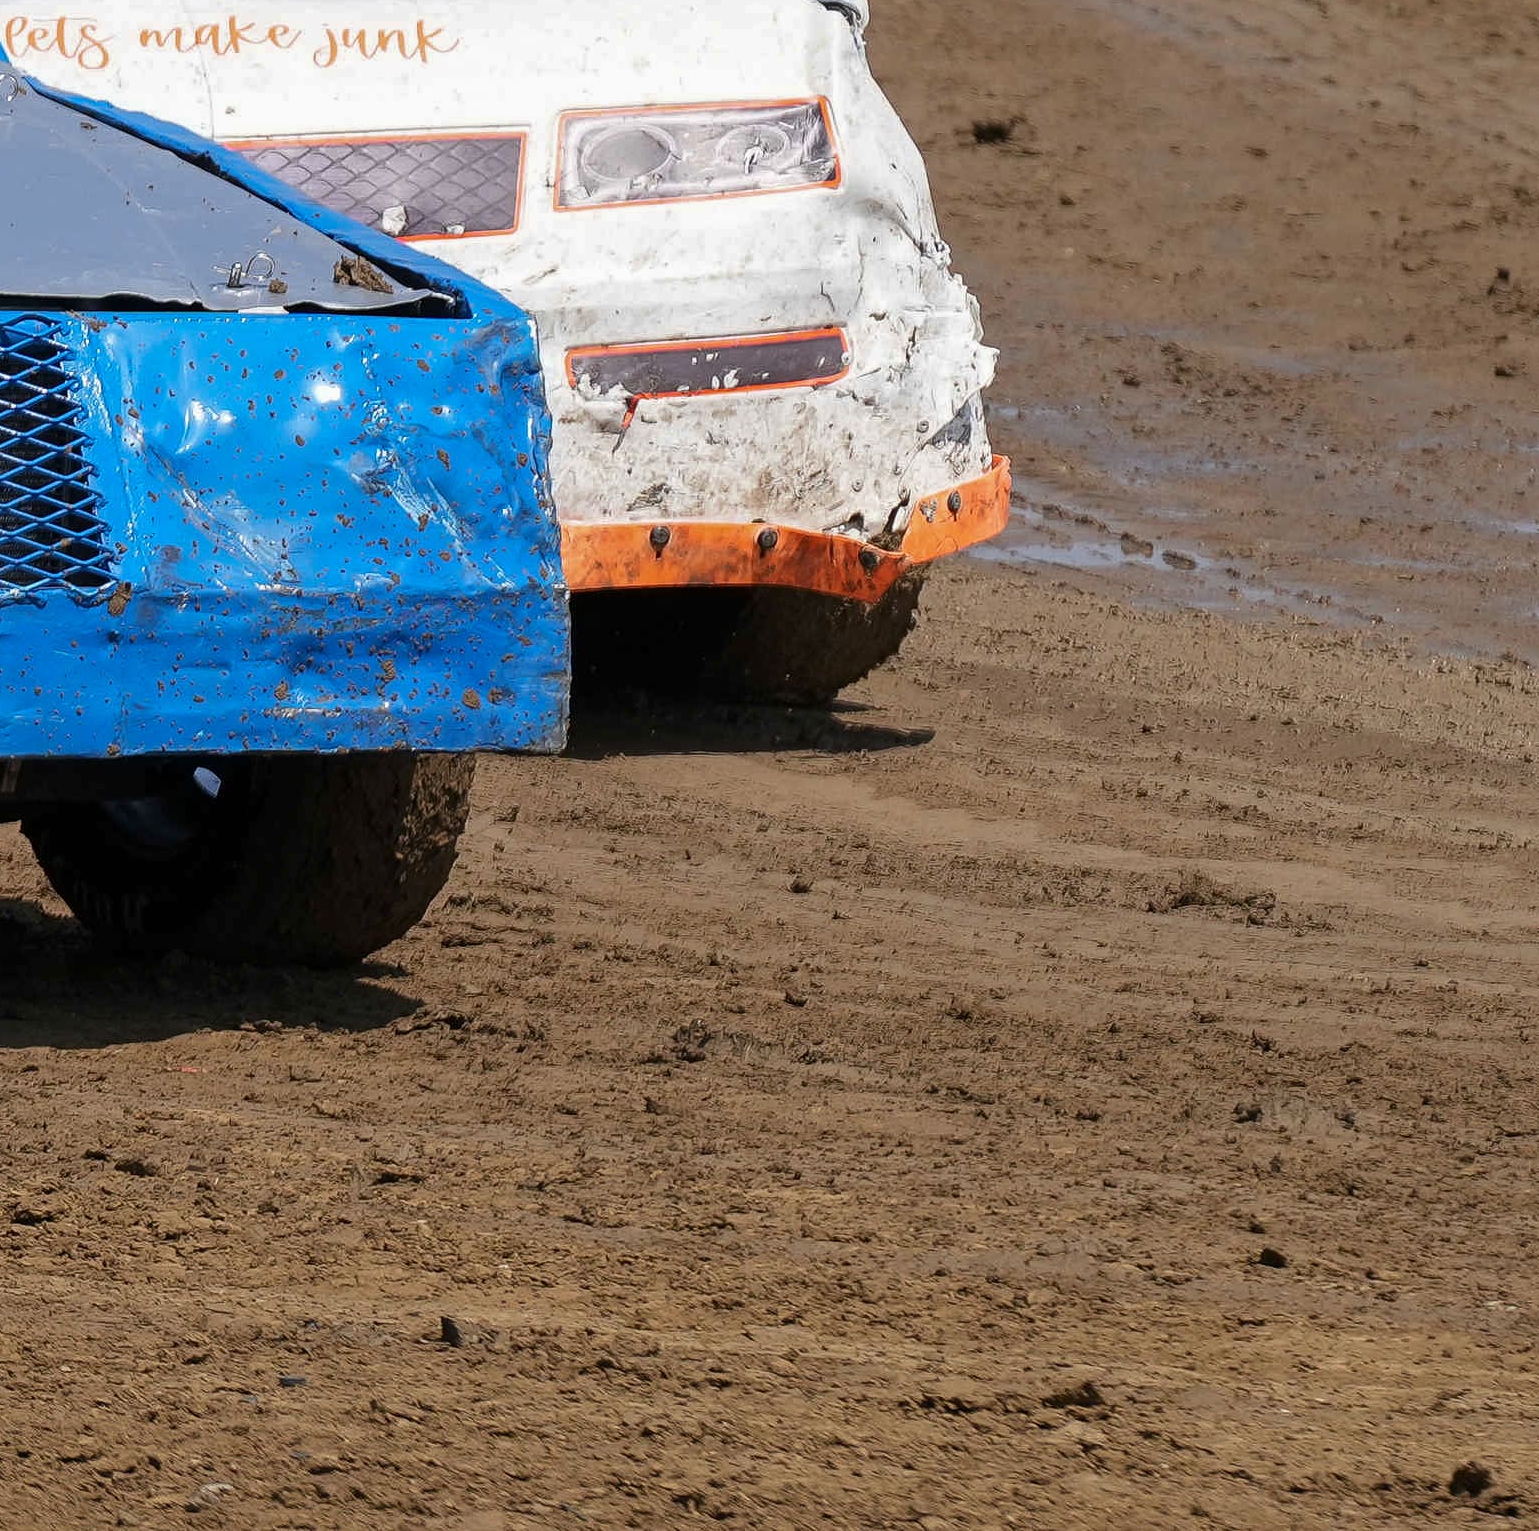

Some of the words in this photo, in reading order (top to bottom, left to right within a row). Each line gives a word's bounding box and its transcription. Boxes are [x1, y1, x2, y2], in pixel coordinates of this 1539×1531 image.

[4, 15, 118, 69] lets
[139, 15, 302, 56] make
[312, 19, 461, 69] junk
